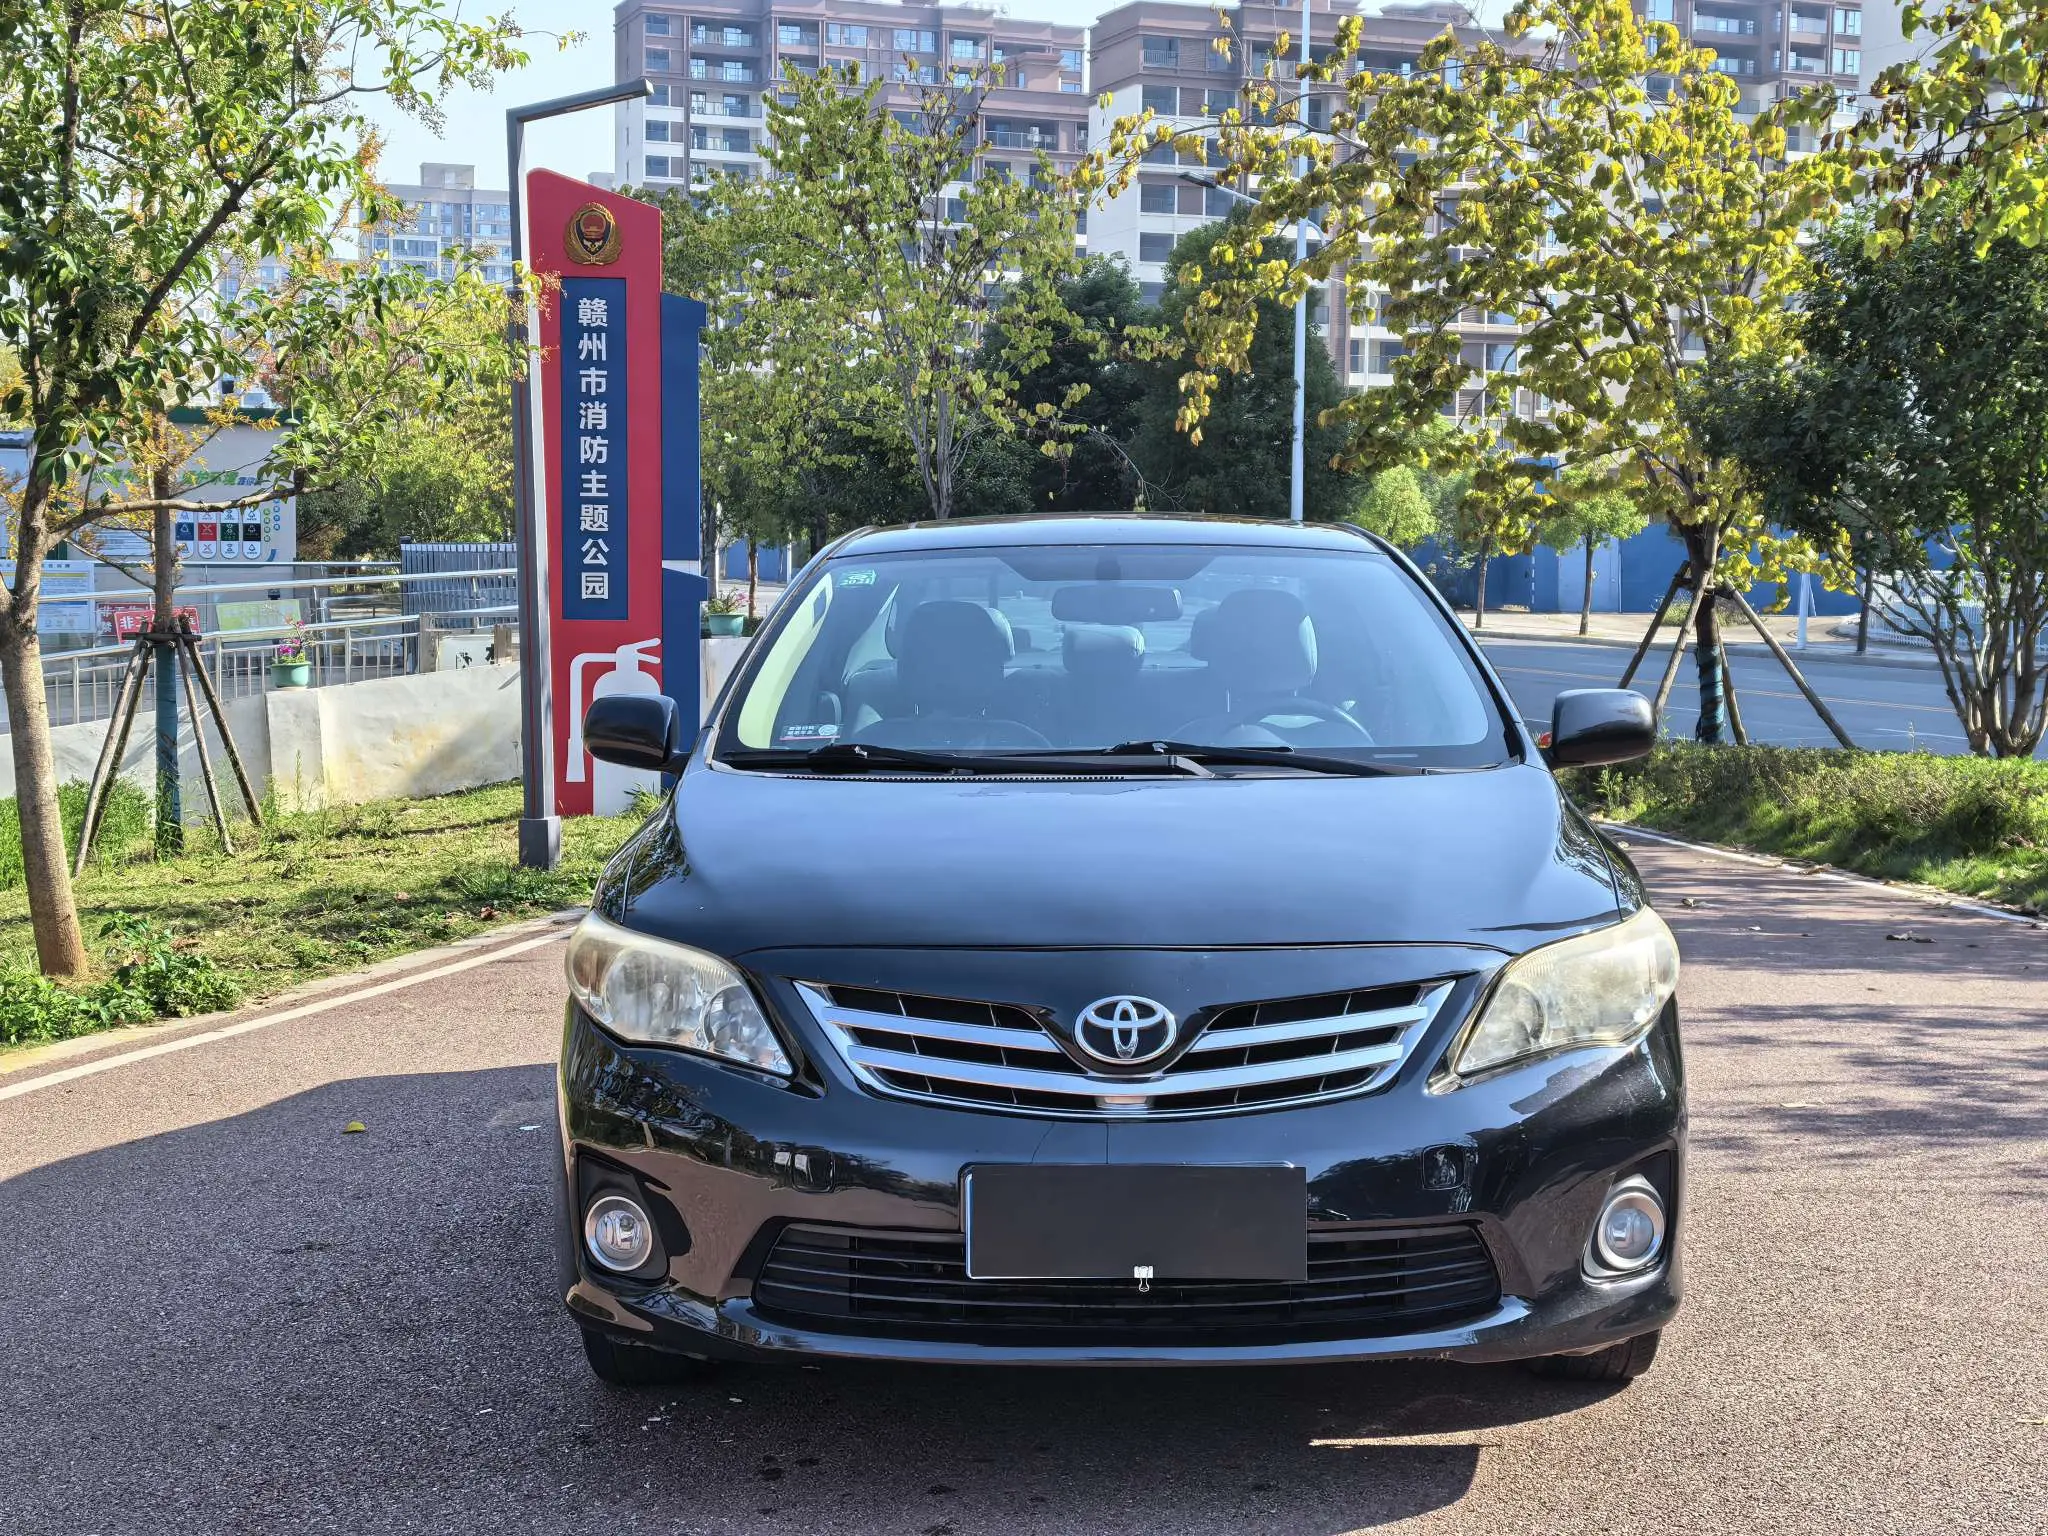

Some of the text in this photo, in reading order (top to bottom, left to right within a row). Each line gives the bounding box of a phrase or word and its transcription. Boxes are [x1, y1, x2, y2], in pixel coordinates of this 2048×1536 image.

[577, 297, 610, 600] 赣州市消防主题公园
